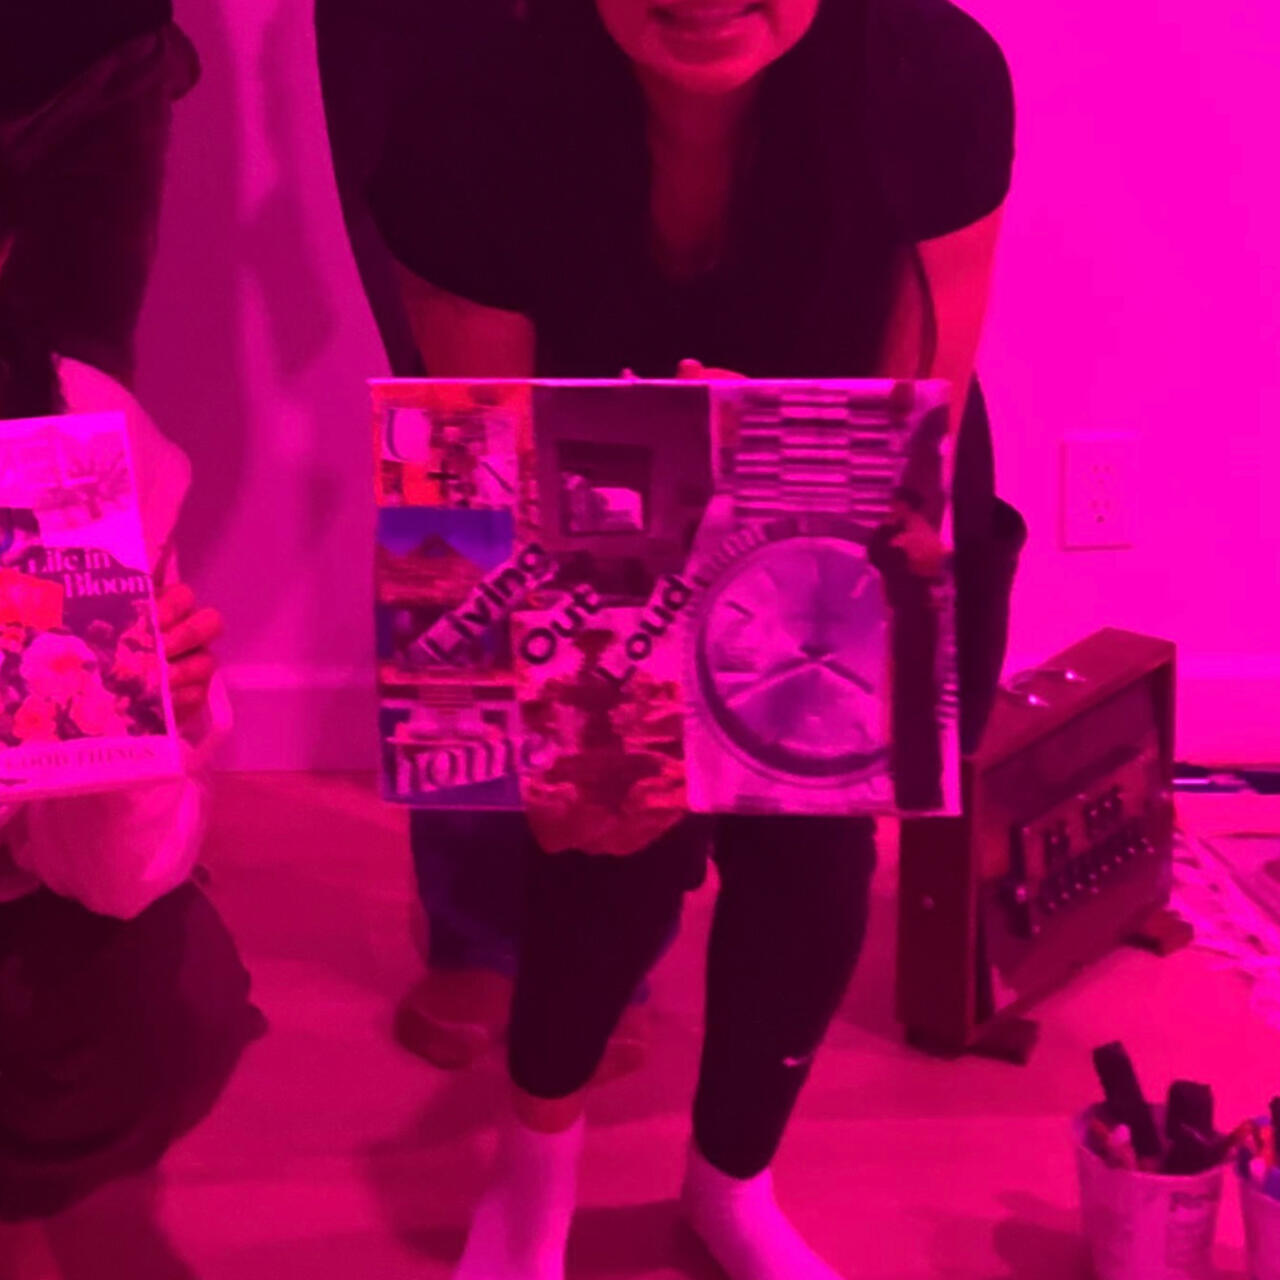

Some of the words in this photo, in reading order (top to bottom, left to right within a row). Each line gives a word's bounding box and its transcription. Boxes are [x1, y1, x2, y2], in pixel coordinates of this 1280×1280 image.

[63, 572, 154, 598] Bloom
[425, 542, 553, 661] Living
[520, 582, 602, 664] Out
[595, 574, 691, 687] Loud
